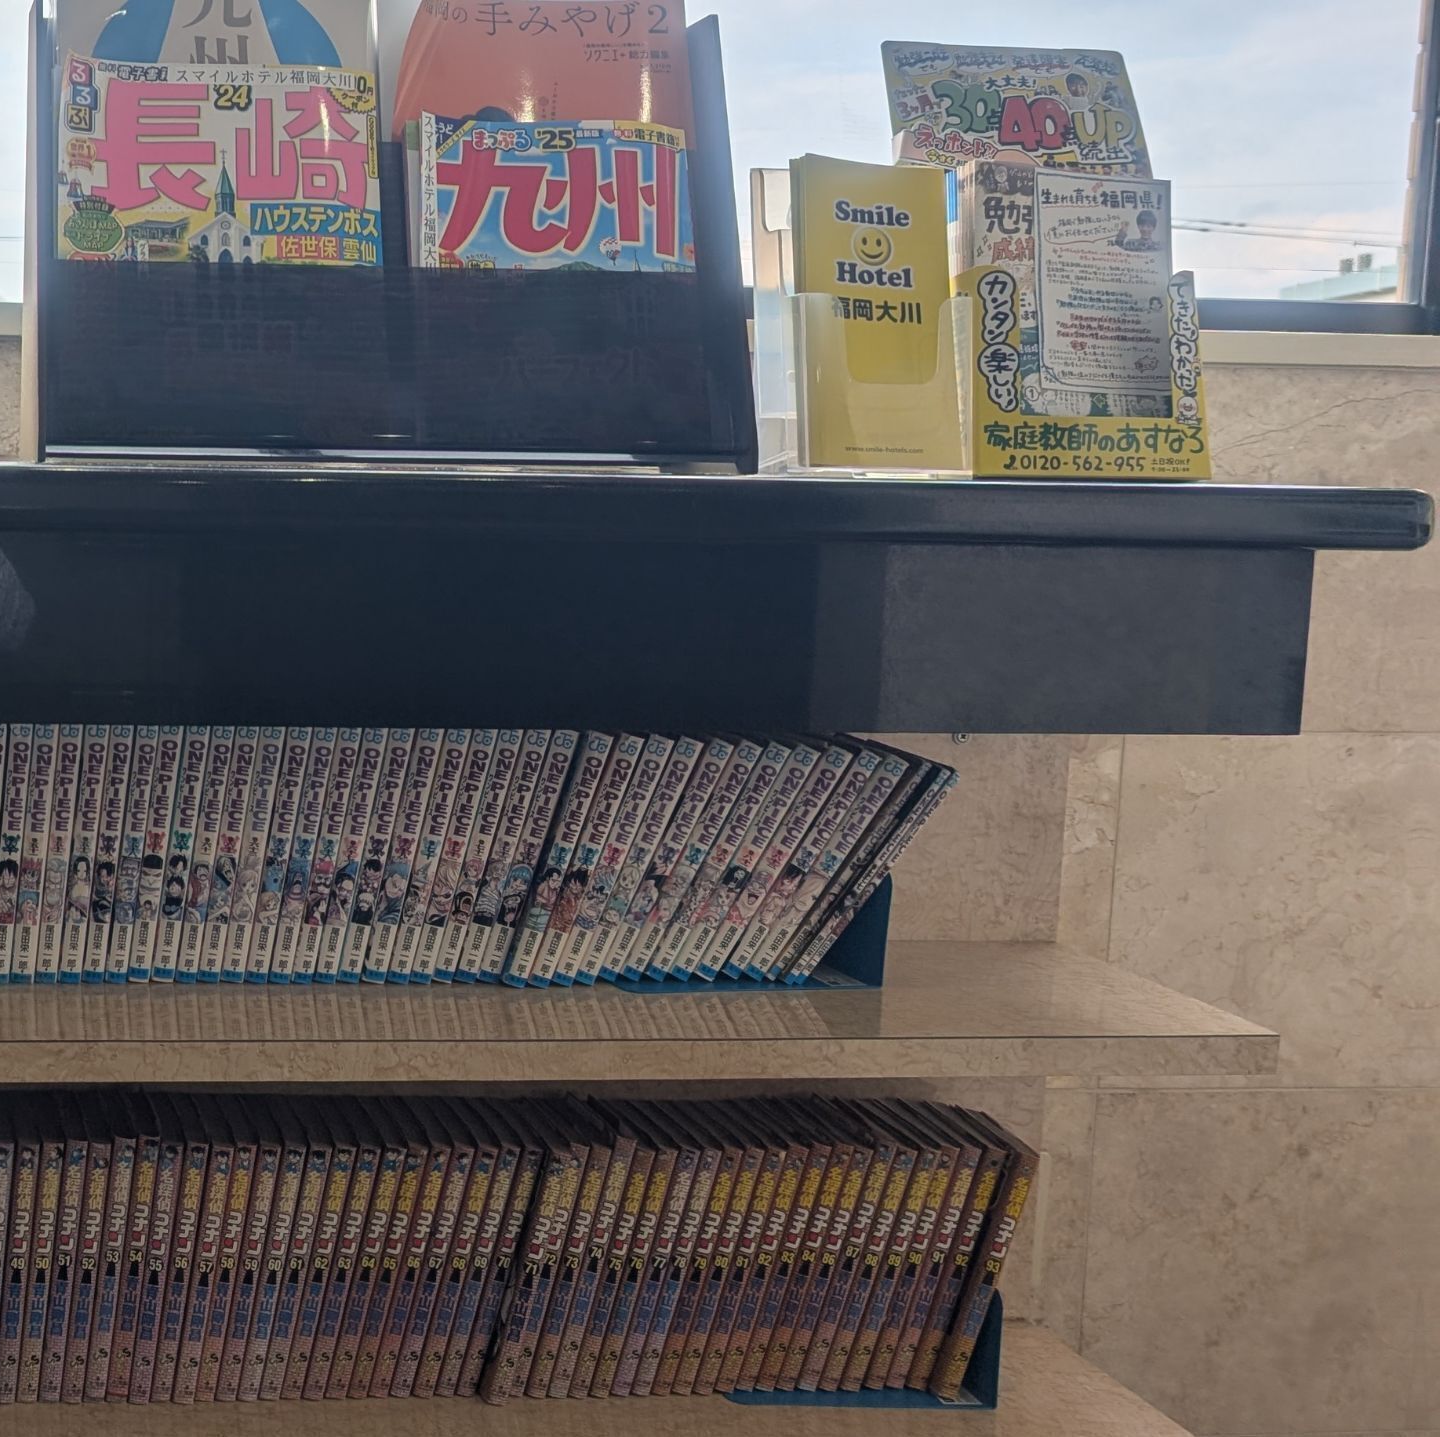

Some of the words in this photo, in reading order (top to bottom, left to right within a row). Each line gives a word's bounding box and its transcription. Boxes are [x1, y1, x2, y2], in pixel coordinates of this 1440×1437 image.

[176, 69, 355, 91] スマイルホテル福岡大川
[67, 62, 92, 127] るるぶ
[87, 78, 367, 211] 長崎
[473, 128, 532, 151] まっぷる
[436, 140, 677, 258] 九州
[254, 206, 379, 236] ハウステンボス
[835, 200, 910, 227] Smile
[280, 236, 338, 258] 佐世保
[343, 239, 377, 263] 雲仙
[836, 261, 913, 288] Hotel
[832, 296, 922, 324] 福岡大川
[984, 421, 1205, 453] 家庭教師のあすなろ
[1020, 454, 1147, 472] 0120-562-955
[59, 741, 77, 773] ONE
[288, 745, 305, 779] ONE
[579, 756, 602, 789] ONE
[666, 760, 688, 789] ONE
[55, 777, 74, 832] PIECE
[279, 781, 302, 833] PIECE
[560, 792, 588, 844] PIECE
[641, 790, 675, 844] PIECE
[58, 1254, 71, 1265] 51
[129, 1250, 143, 1262] 54
[314, 1257, 328, 1269] 62
[429, 1257, 443, 1268] 67
[590, 1246, 604, 1258] 74
[846, 1245, 859, 1257] 87
[954, 1253, 968, 1265] 92
[986, 1260, 1000, 1272] 93
